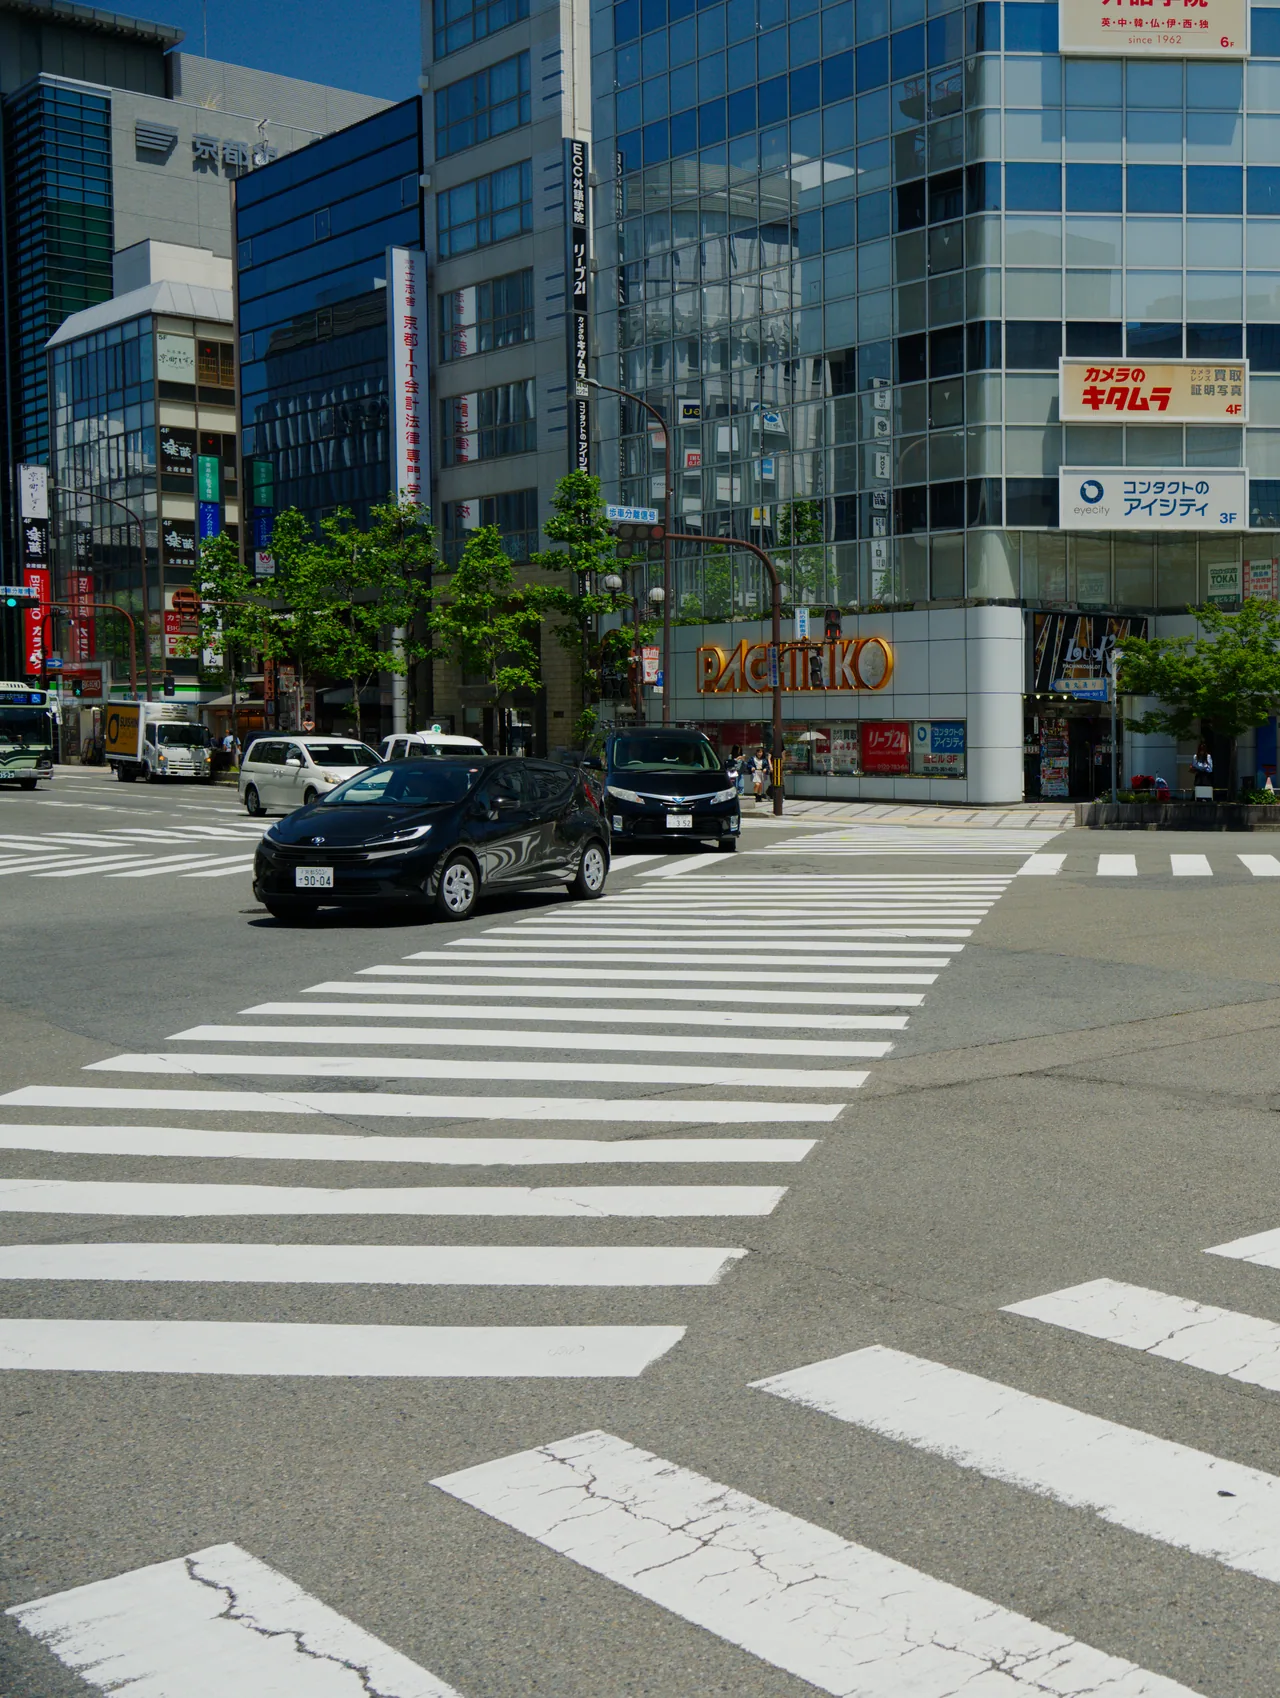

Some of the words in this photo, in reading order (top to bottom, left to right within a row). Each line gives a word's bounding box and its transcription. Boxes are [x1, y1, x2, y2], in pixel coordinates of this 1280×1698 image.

[1101, 18, 1209, 29] 英・中・韓・仏・伊・西・独
[1128, 34, 1152, 44] since
[1157, 35, 1182, 44] 1962
[1220, 37, 1234, 47] 6F
[574, 244, 586, 295] リーブ21
[577, 341, 586, 379] キタムラ
[1084, 368, 1146, 383] カメラの
[1214, 369, 1242, 382] 買取
[1191, 384, 1242, 396] 証明写真
[1082, 386, 1172, 411] キタムラ
[1226, 405, 1242, 415] 4F
[1124, 481, 1209, 495] コンタクトの
[1074, 506, 1110, 516] eyecity
[1124, 498, 1209, 516] アイシティ
[609, 508, 655, 521] 歩車分離信号
[1219, 513, 1237, 524] 3F
[1211, 574, 1237, 584] TOKAI
[697, 638, 895, 694] PACHINKO
[933, 728, 964, 737] コンタクトの
[869, 730, 905, 748] リーブ21
[934, 737, 964, 748] アイシティ
[946, 755, 958, 764] 3F
[304, 875, 332, 887] 90-04
